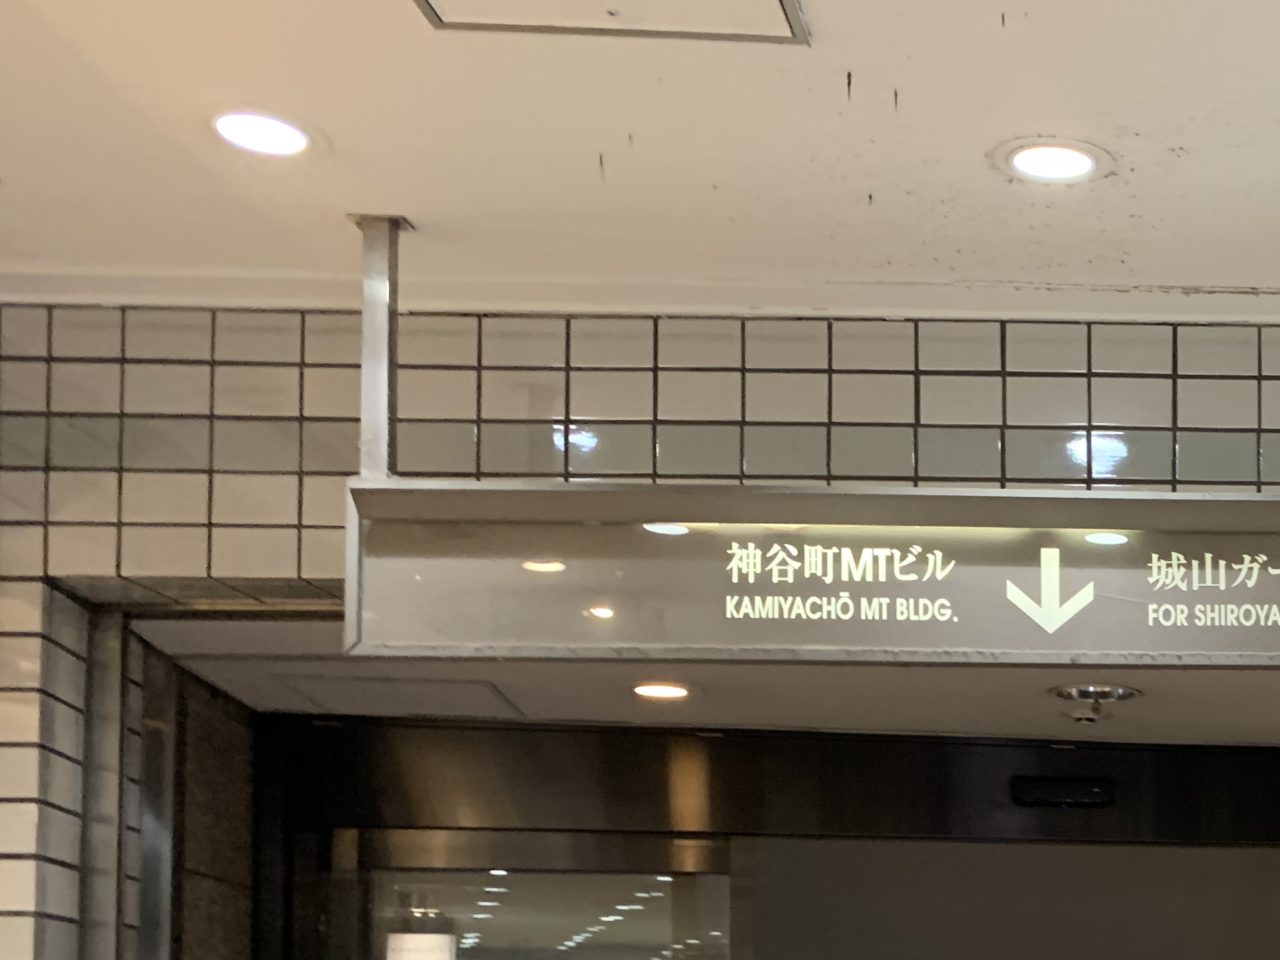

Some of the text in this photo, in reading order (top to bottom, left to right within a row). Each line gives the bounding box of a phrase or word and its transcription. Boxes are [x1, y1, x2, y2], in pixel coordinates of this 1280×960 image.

[726, 541, 956, 584] 神谷町MTビル
[725, 592, 959, 622] KAMIYACHŌ MT BLDG.
[1147, 603, 1189, 626] FOR
